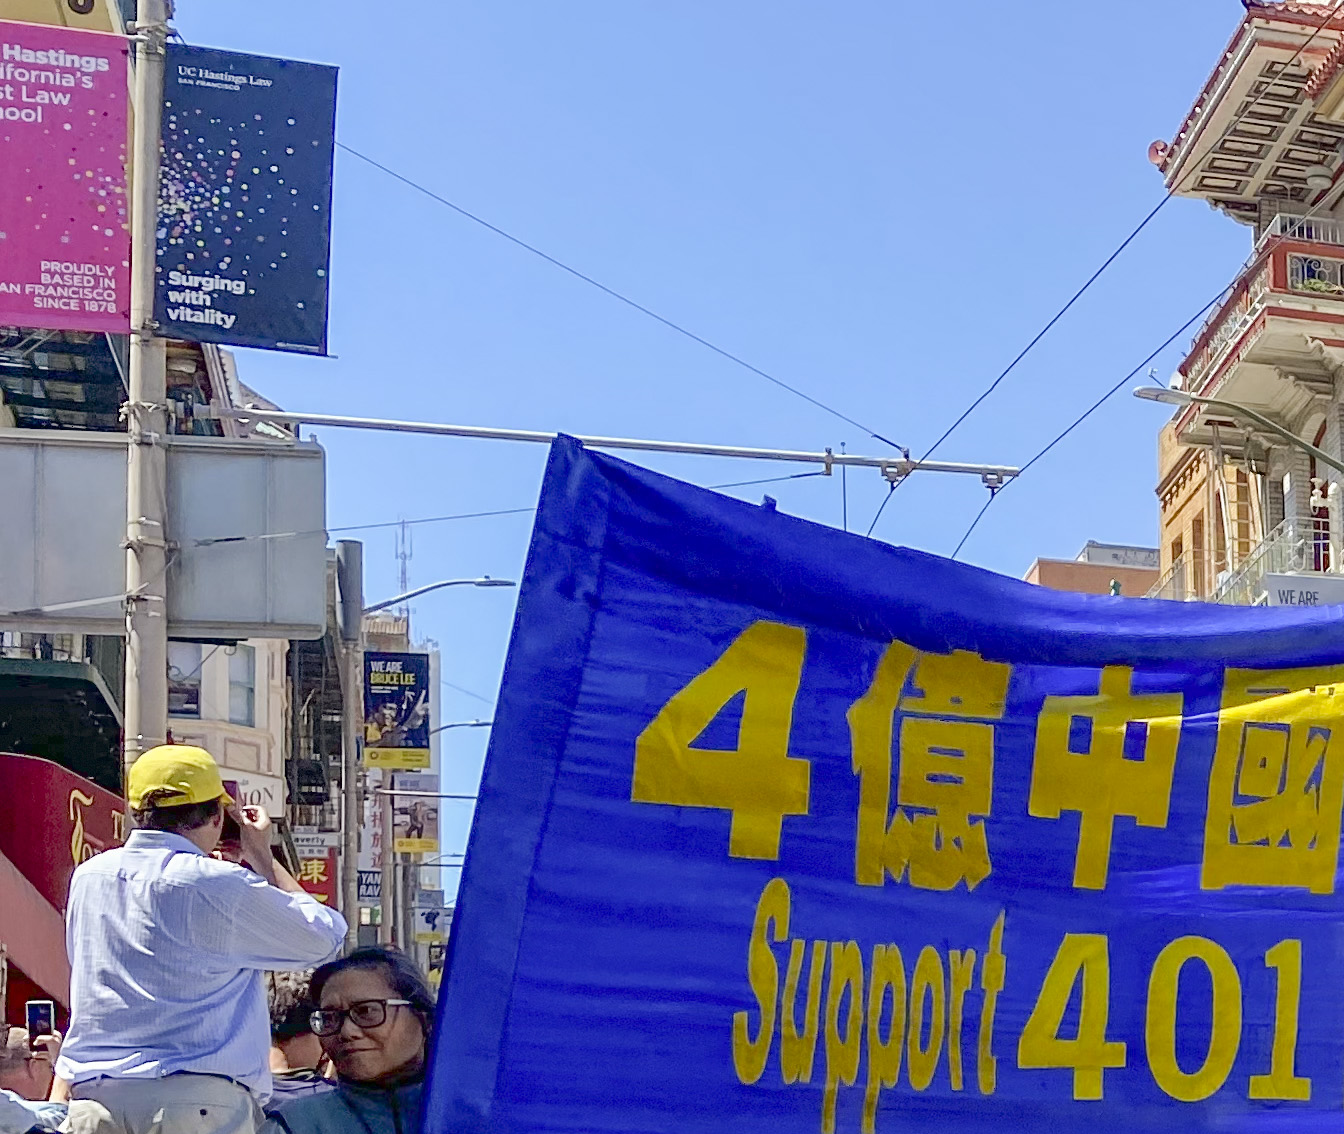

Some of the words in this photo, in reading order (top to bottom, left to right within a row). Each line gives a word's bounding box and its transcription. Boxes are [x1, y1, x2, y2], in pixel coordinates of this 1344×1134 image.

[2, 43, 110, 73] Hastings
[177, 66, 197, 78] UC
[198, 68, 248, 85] Hastings
[249, 75, 273, 87] Law
[21, 85, 71, 106] Law
[40, 260, 116, 277] PROUDLY
[40, 272, 95, 287] BASED
[99, 277, 116, 289] IN
[167, 270, 246, 295] Surging
[25, 283, 117, 301] FRANCISCO
[167, 289, 211, 306] with
[33, 297, 80, 311] SINCE
[83, 300, 117, 314] 1878
[166, 306, 236, 329] vitality
[1277, 589, 1296, 605] WE
[370, 661, 385, 672] WE
[386, 661, 403, 673] ARE
[1018, 934, 1311, 1102] 401
